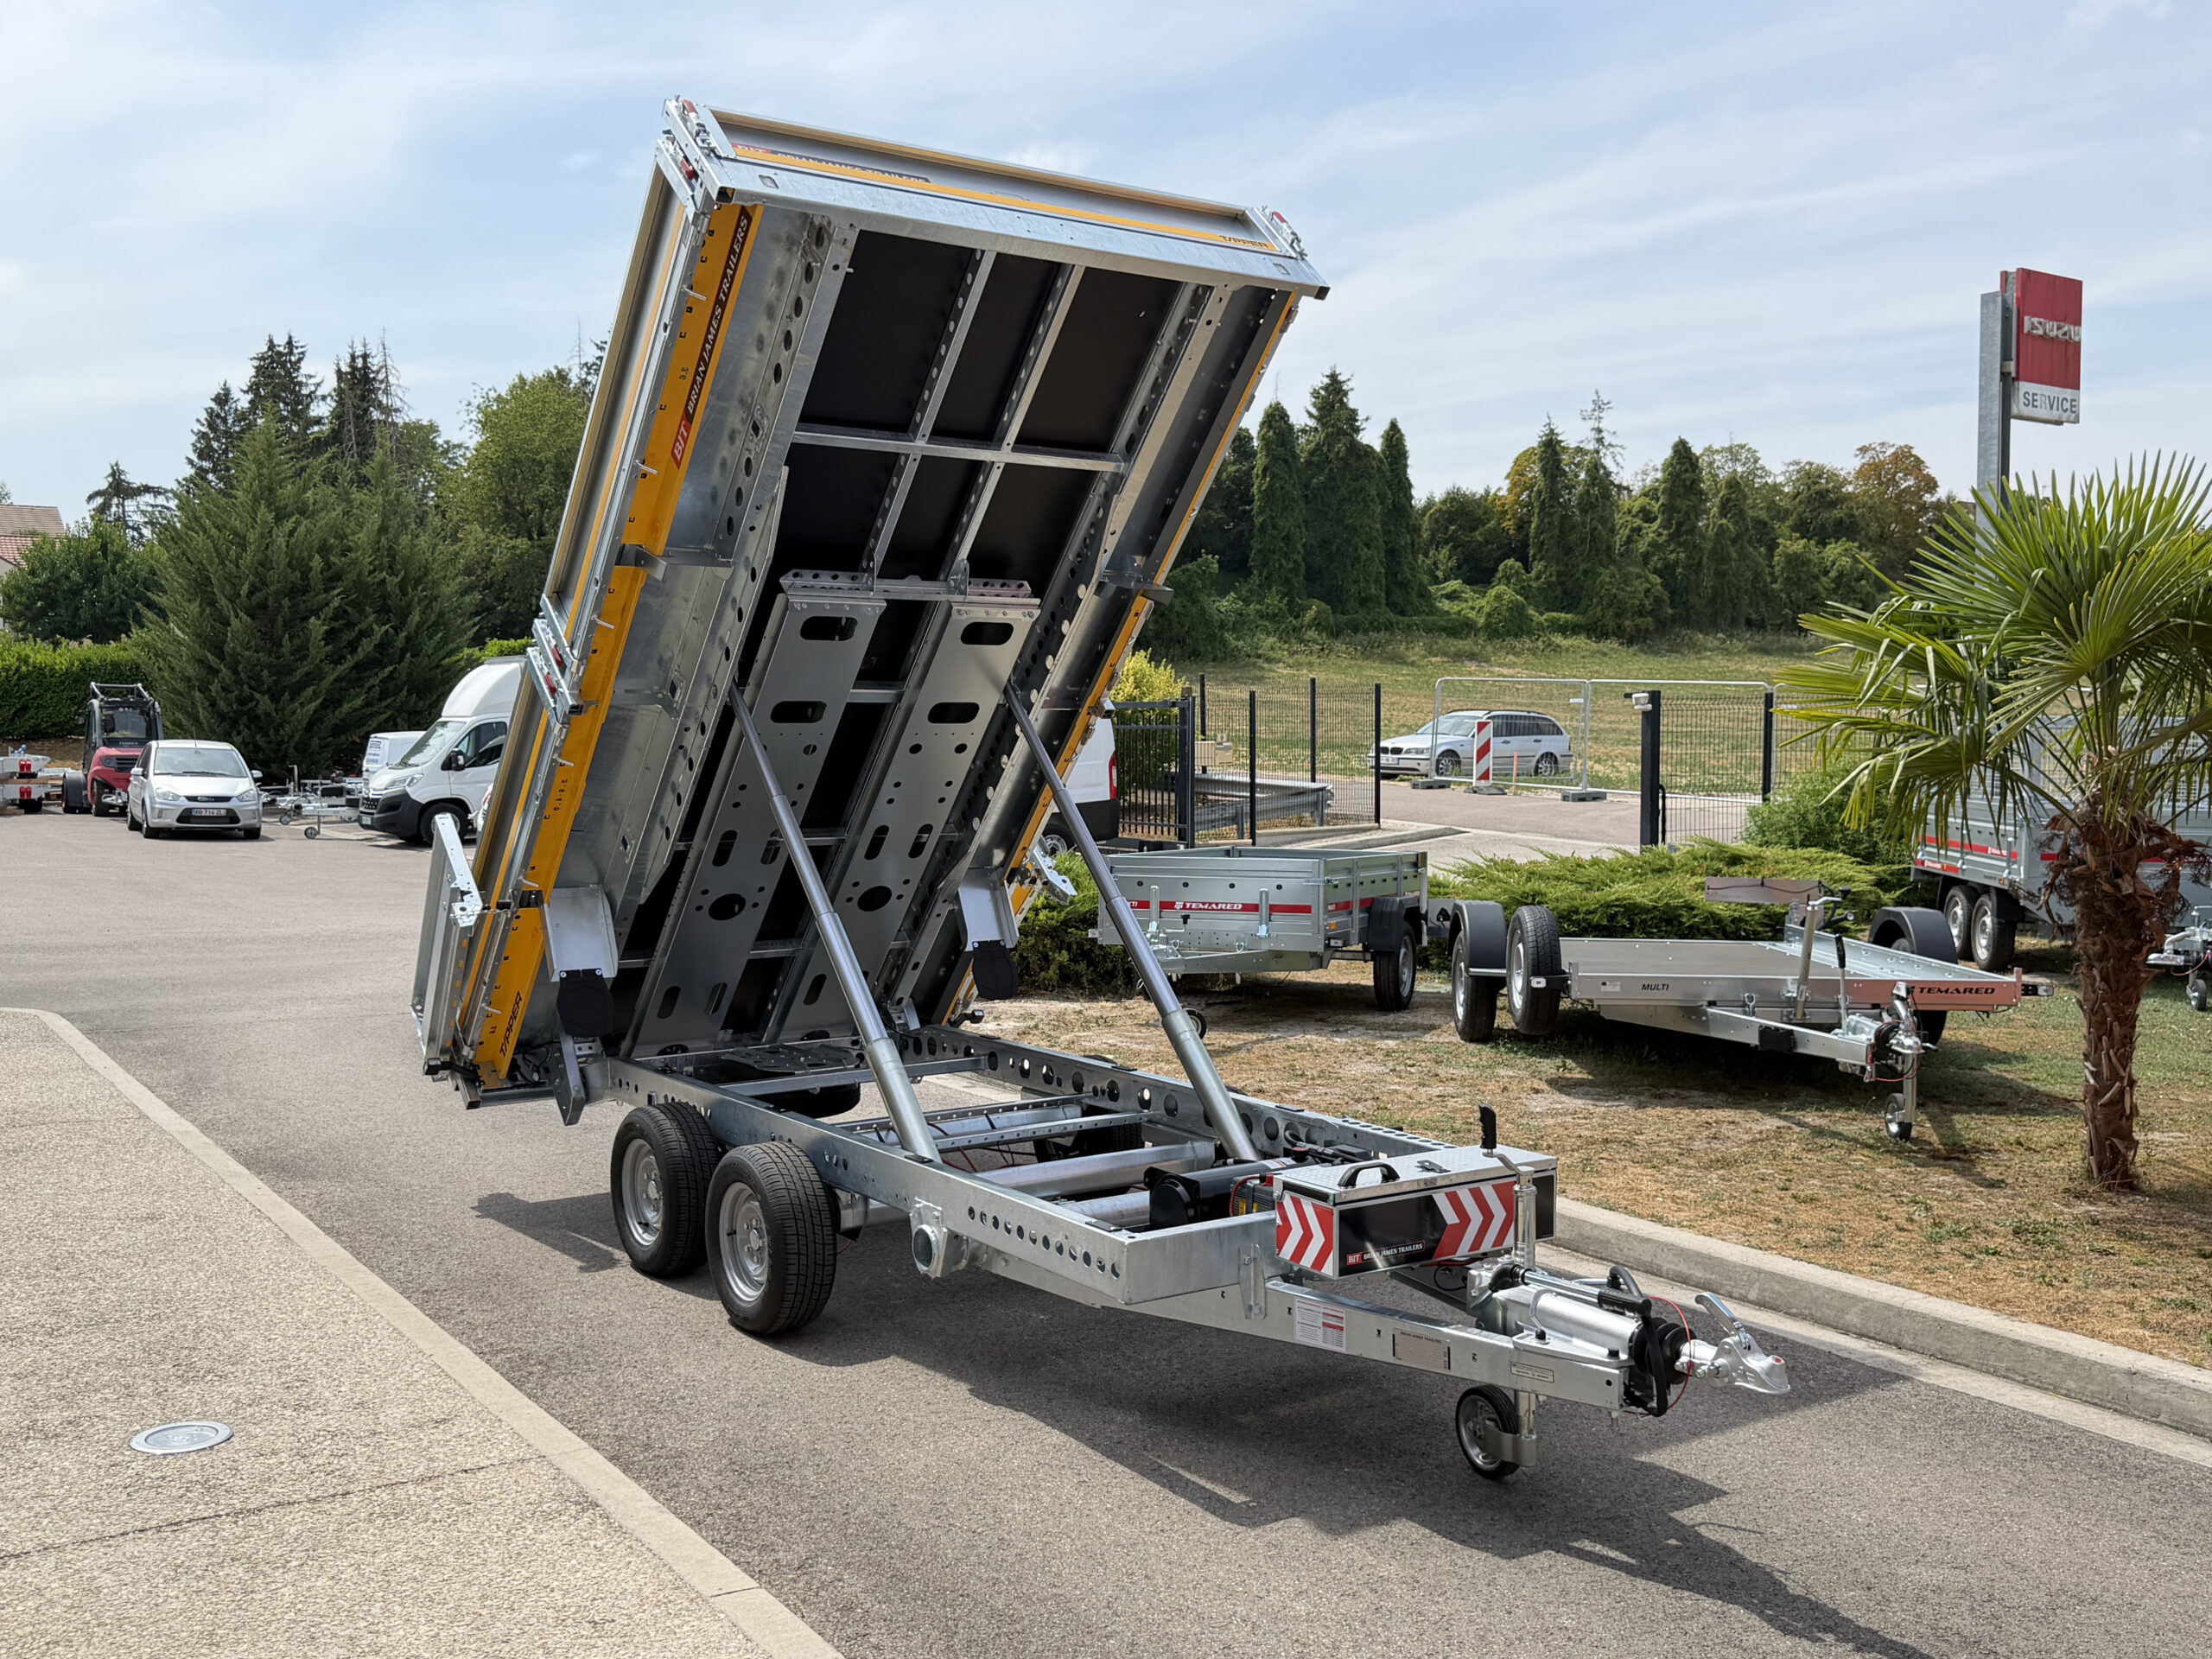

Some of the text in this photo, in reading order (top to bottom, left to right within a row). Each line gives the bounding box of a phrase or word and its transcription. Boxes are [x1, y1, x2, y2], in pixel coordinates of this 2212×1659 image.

[1219, 235, 1268, 248] TIPPER
[673, 215, 748, 462] BJT BRIAN JAMES TRAILERS
[2024, 315, 2082, 342] ISUZU
[2023, 391, 2077, 414] SERVICE
[499, 990, 523, 1058] TIPPER
[1348, 1254, 1360, 1263] BJT
[1380, 1248, 1397, 1257] JAMES
[1398, 1243, 1423, 1253] TRAILERS
